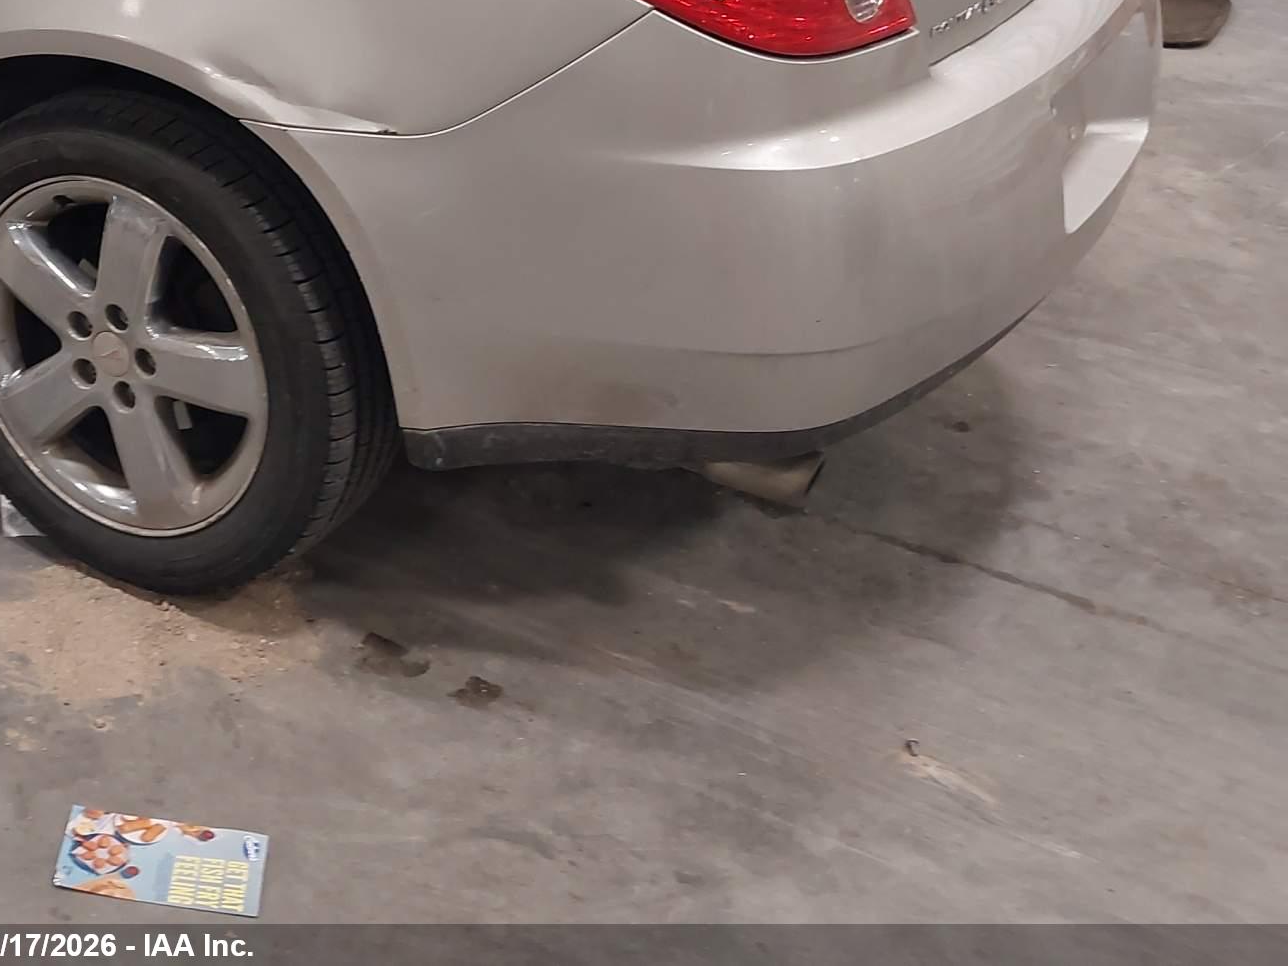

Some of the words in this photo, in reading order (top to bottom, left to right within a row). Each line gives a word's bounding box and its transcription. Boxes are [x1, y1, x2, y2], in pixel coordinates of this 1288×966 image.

[167, 855, 201, 905] FEELING
[199, 857, 226, 883] FISH
[225, 860, 249, 882] GET
[194, 885, 222, 909] FRY
[221, 883, 248, 912] THAT
